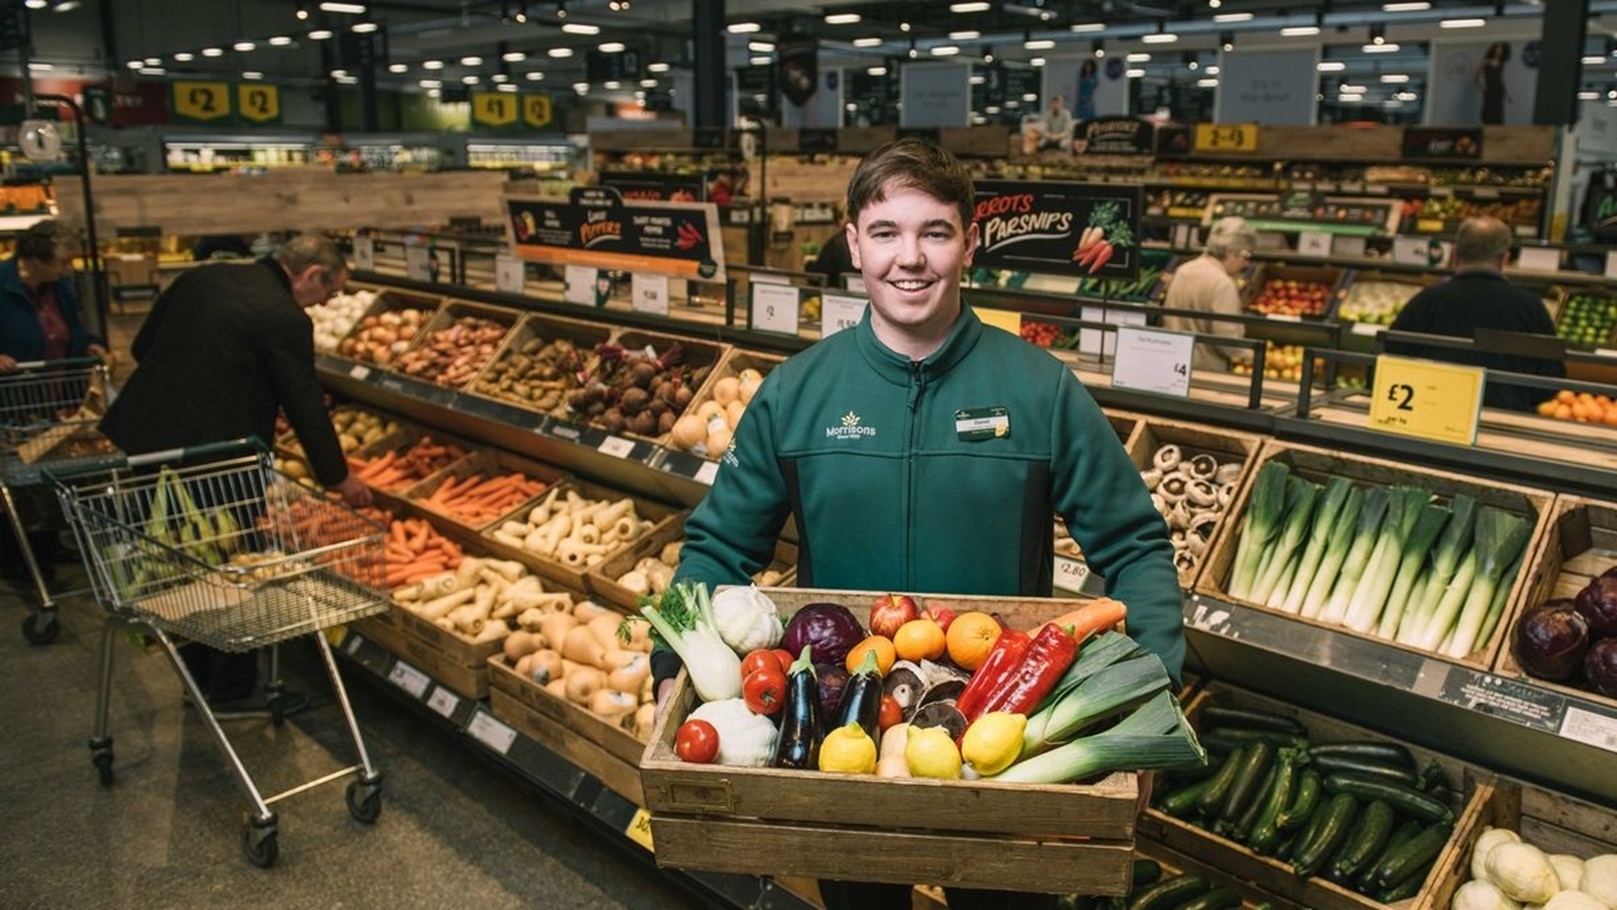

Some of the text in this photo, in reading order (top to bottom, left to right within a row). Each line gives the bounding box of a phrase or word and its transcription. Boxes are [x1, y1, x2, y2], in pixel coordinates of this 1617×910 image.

[189, 88, 215, 112] £2
[248, 89, 268, 113] £2
[487, 98, 504, 119] £1
[972, 194, 1034, 220] RROTS
[984, 211, 1073, 248] PARSNIPS
[1173, 363, 1187, 377] £4
[1387, 384, 1415, 411] £2
[826, 425, 876, 438] Morrisons
